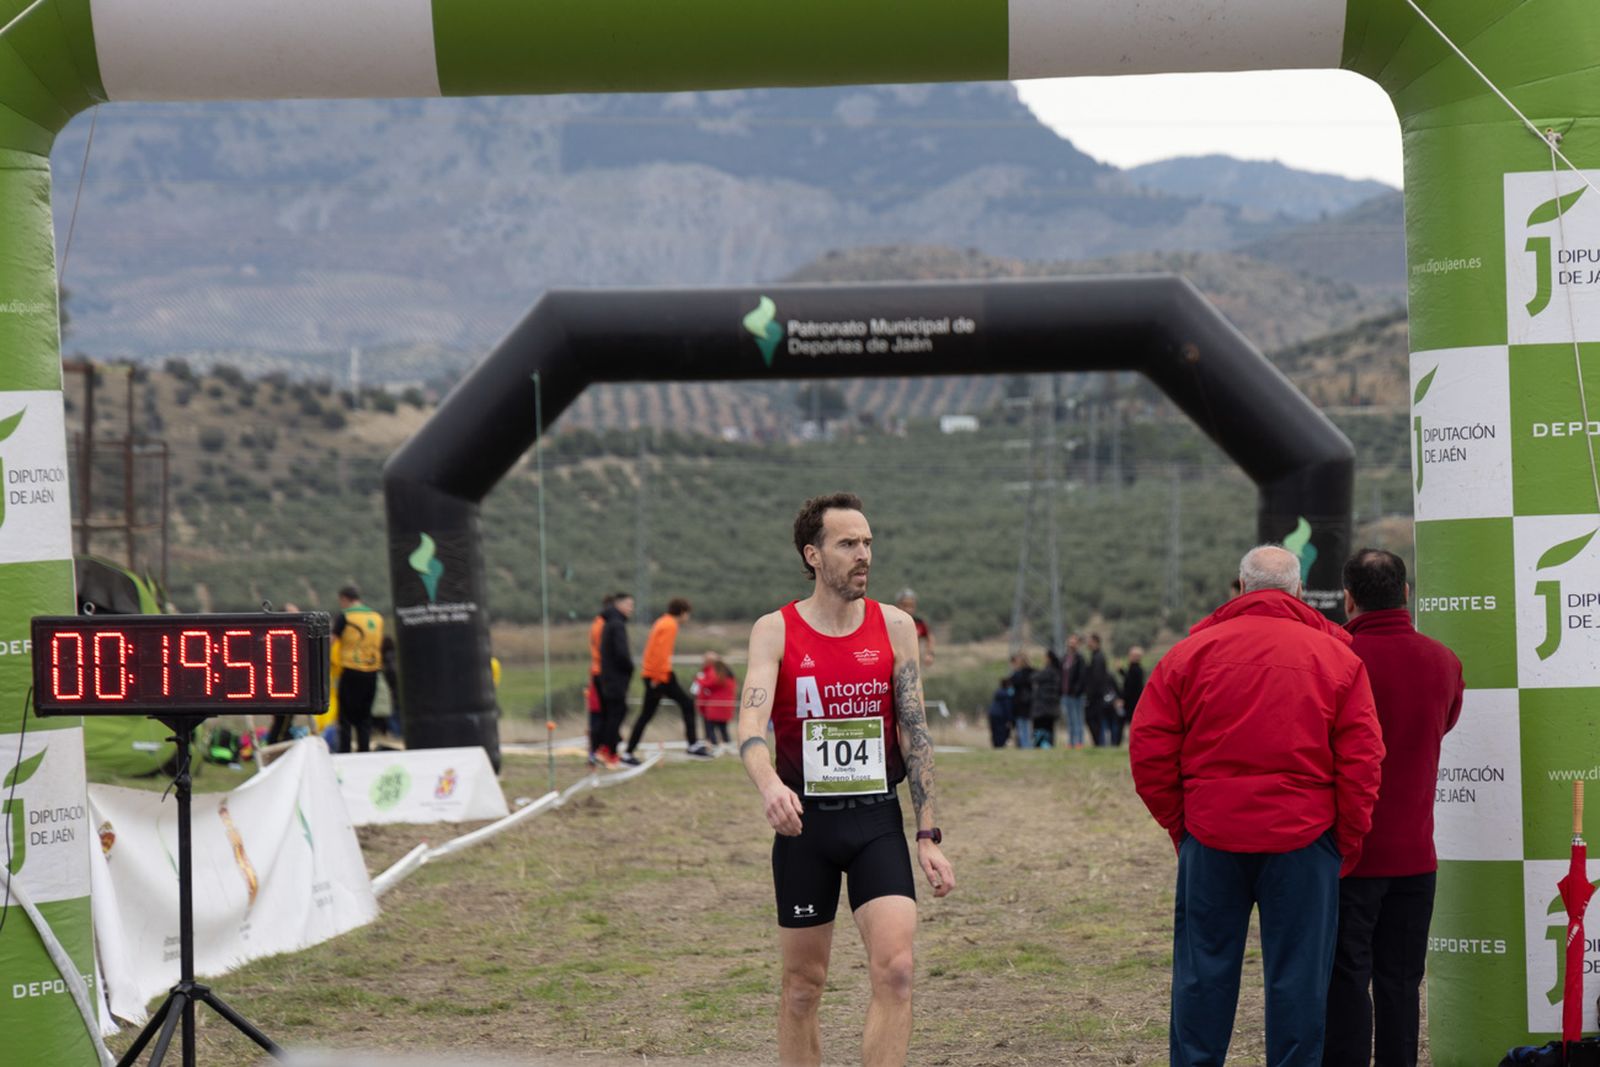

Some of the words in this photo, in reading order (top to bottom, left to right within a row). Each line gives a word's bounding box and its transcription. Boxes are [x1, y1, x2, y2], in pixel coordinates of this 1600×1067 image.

[1559, 271, 1582, 285] DE
[787, 319, 867, 337] Patronato
[869, 316, 950, 337] Municipal
[952, 316, 976, 334] de
[787, 337, 864, 357] Deportes
[866, 337, 889, 353] de
[891, 334, 933, 352] Jaén
[1424, 423, 1495, 442] DIPUTACIÓN
[1425, 450, 1437, 463] DE
[1438, 446, 1466, 462] JAÉN
[10, 490, 28, 505] DE
[1419, 596, 1496, 612] DEPORTES
[1569, 615, 1593, 629] DE
[51, 630, 298, 699] 00:19:50
[817, 740, 869, 767] 104
[1448, 787, 1475, 803] JAÉN
[31, 831, 48, 846] DE
[1427, 937, 1506, 954] DEPORTES
